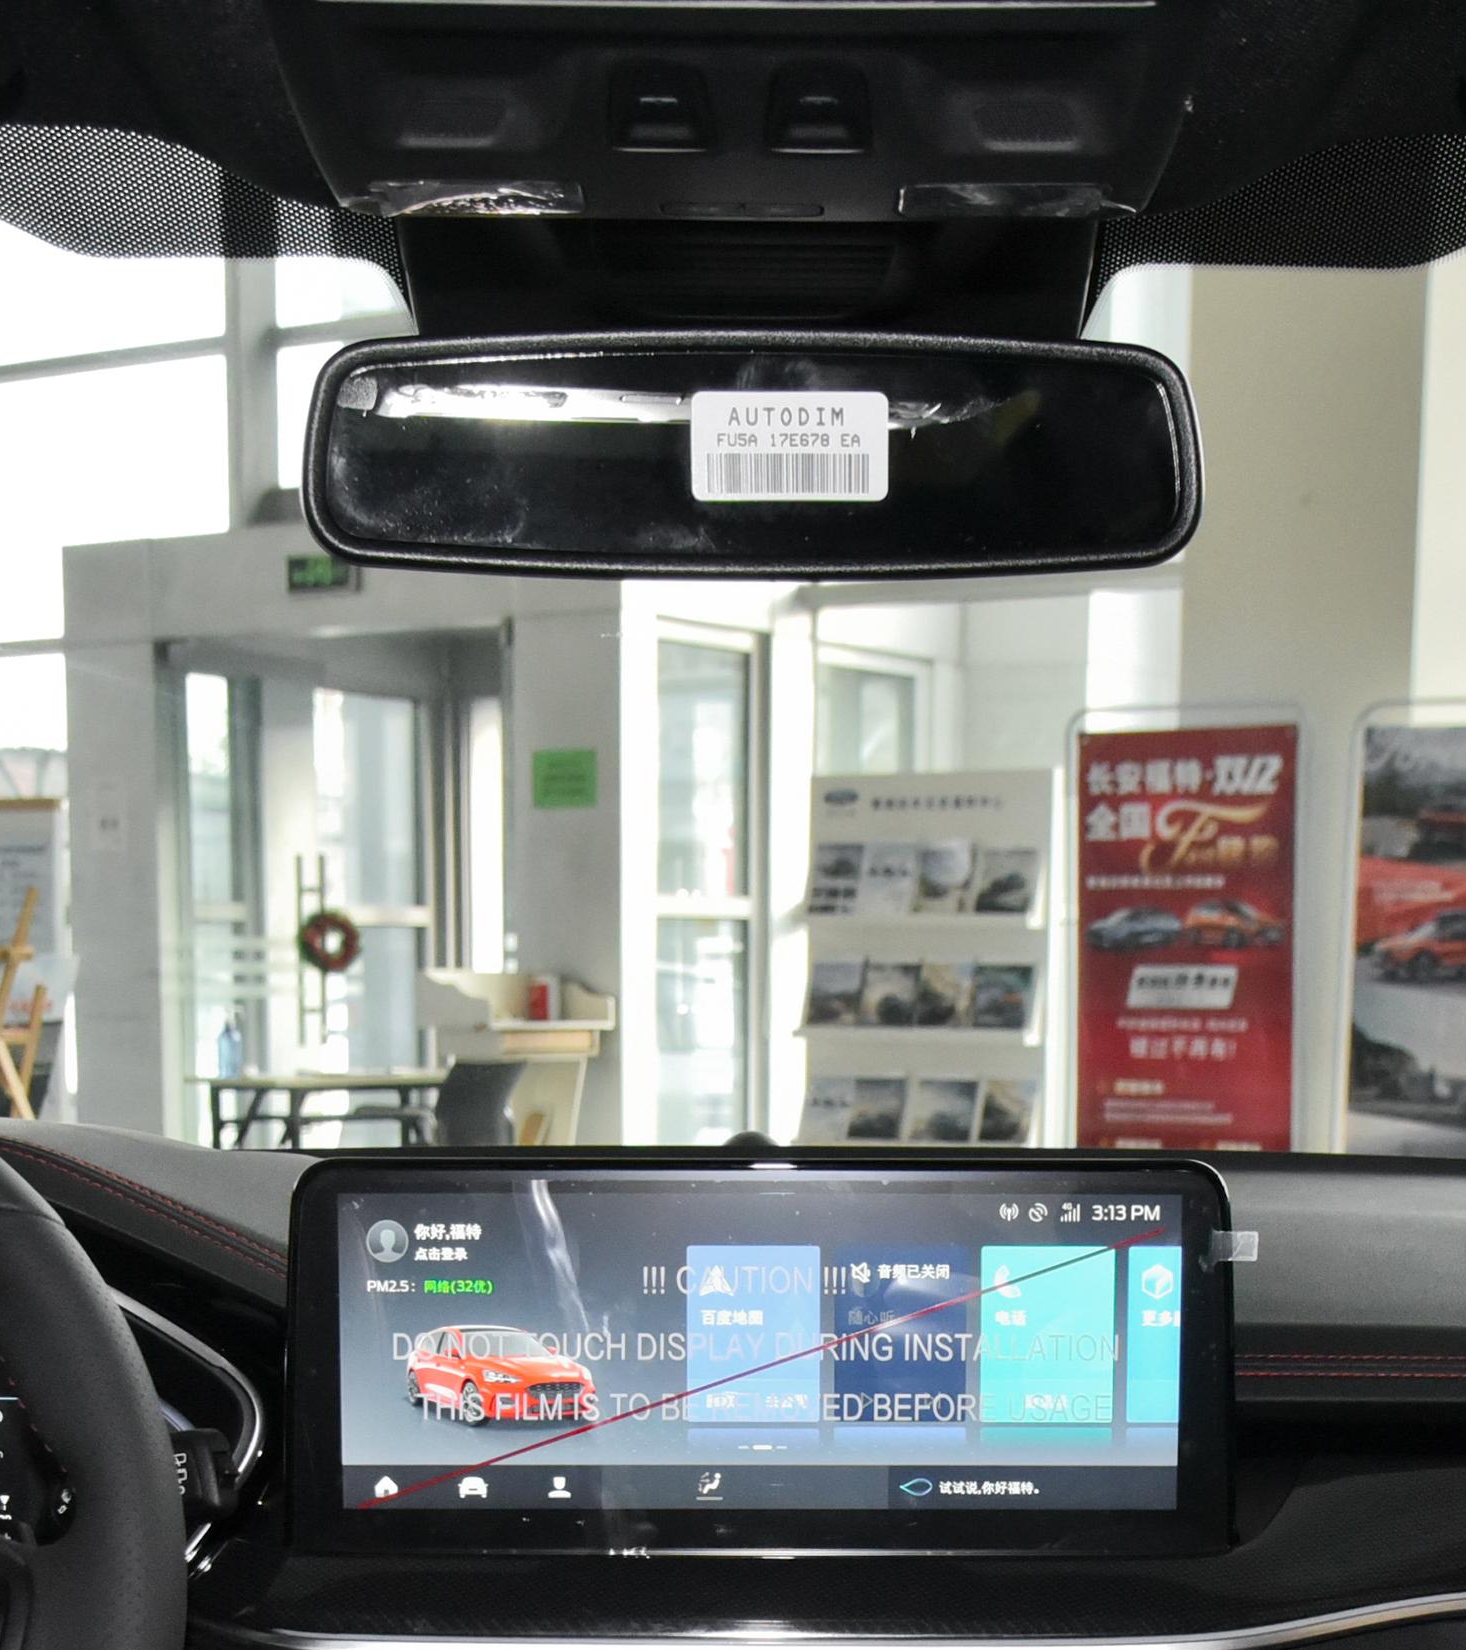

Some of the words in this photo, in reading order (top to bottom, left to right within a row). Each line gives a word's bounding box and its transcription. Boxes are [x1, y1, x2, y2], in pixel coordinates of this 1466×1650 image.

[727, 407, 845, 427] AUTODIM
[716, 433, 758, 448] FU5A
[770, 433, 831, 448] 17E678
[840, 433, 862, 448] EA
[1092, 1204, 1127, 1222] 3:13
[1131, 1204, 1162, 1222] PM
[414, 1247, 468, 1261] 点击登录
[676, 1265, 813, 1294] CAUTION
[877, 1263, 951, 1280] 音频已关闭
[700, 1309, 764, 1326] 百度地图
[994, 1309, 1028, 1328] 电话
[392, 1333, 435, 1361] DO
[446, 1333, 507, 1361] NOT
[524, 1333, 625, 1361] TOUCH
[637, 1333, 764, 1361] DISPLAY
[776, 1333, 893, 1361] DURING
[904, 1333, 1119, 1361] INSTALLATION
[418, 1393, 485, 1422] THIS
[495, 1393, 563, 1422] FILM
[573, 1393, 600, 1422] IS
[609, 1393, 651, 1422] TO
[661, 1393, 700, 1422] BE
[873, 1393, 997, 1422] BEFORE
[1009, 1393, 1112, 1422] USAGE
